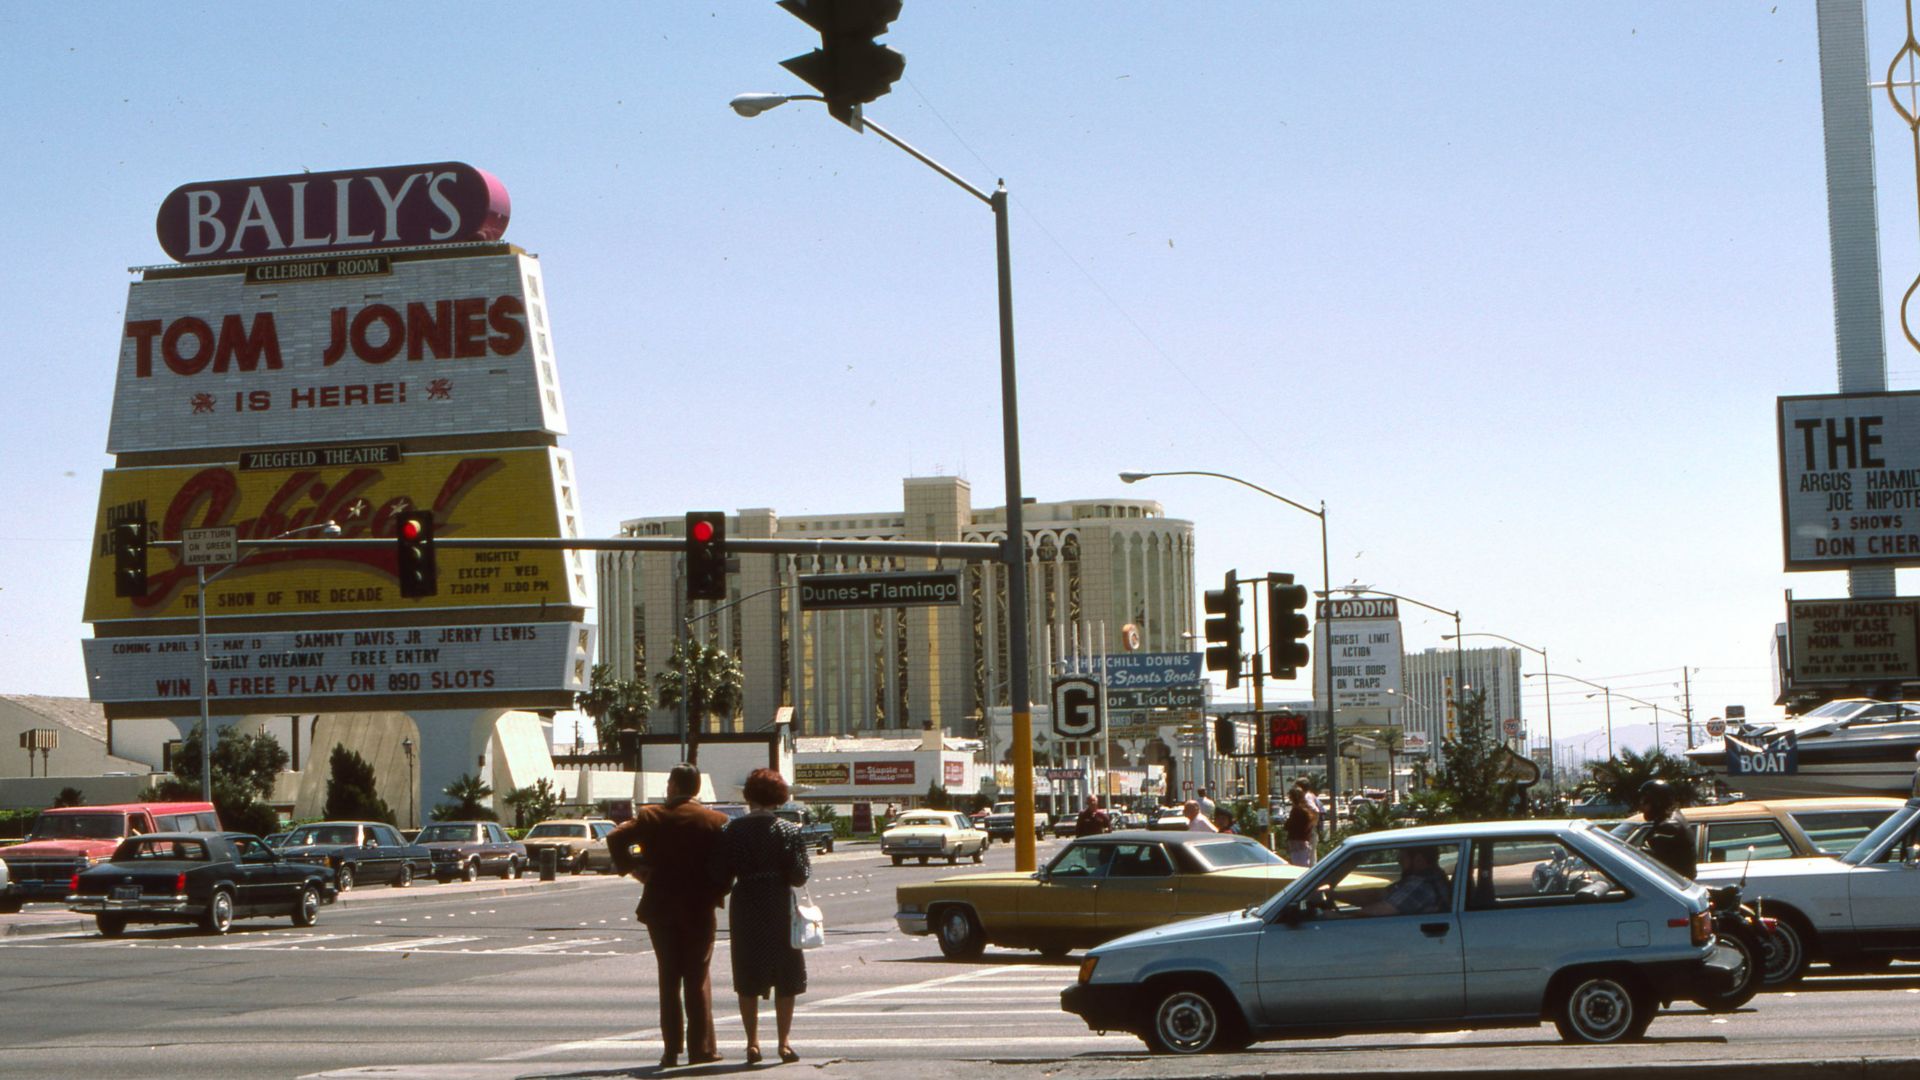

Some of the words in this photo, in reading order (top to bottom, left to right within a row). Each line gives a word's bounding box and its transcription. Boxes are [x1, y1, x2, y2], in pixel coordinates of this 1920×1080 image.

[185, 171, 461, 257] BALLY'S
[256, 263, 328, 280] CELEBRITY
[338, 259, 379, 275] ROOM
[126, 312, 283, 377] TOM
[324, 295, 526, 367] JONES
[236, 386, 272, 412] IS
[291, 382, 406, 409] HERE!
[1794, 416, 1885, 471] THE
[250, 451, 316, 468] ZIEGFELD
[324, 447, 389, 465] THEATRE
[1800, 472, 1851, 492] ARGUS
[1827, 492, 1853, 511] JOE
[1831, 517, 1840, 530] 3
[1851, 515, 1903, 529] SHOWS
[188, 531, 207, 540] LEFT
[211, 530, 231, 539] TURN
[189, 543, 199, 551] ON
[207, 542, 231, 550] GREEN
[1816, 538, 1855, 556] DON
[188, 554, 211, 563] ARROW
[215, 553, 232, 562] ONLY
[475, 551, 520, 563] NIGHTLY
[459, 568, 500, 579] EXCEPT
[514, 565, 538, 576] WED
[533, 581, 549, 591] PM
[803, 581, 957, 601] Dunes-Flamingo
[184, 595, 206, 608] TH
[218, 592, 254, 607] SHOW
[267, 591, 283, 605] OF
[296, 589, 321, 604] THE
[330, 587, 383, 602] DECADE
[1795, 604, 1839, 619] SANDY
[1814, 619, 1889, 633] SHOWCASE
[113, 643, 150, 654] COMING
[158, 641, 188, 652] APRIL
[224, 640, 244, 651] MAY
[252, 639, 262, 650] 13
[295, 632, 344, 649] SAMMY
[404, 630, 421, 645] JR
[438, 627, 482, 643] JERRY
[493, 626, 536, 642] LEWIS
[1331, 634, 1359, 645] IGHEST
[1369, 632, 1390, 644] LIMIT
[1854, 633, 1896, 648] NIGHT
[211, 655, 248, 669] DAILY
[259, 652, 325, 668] GIVEAWAY
[351, 650, 386, 666] FREE
[396, 648, 439, 664] ENTRY
[1343, 646, 1371, 657] ACTION
[1146, 655, 1190, 667] DOWNS
[156, 679, 191, 697] WIN
[207, 678, 218, 696] A
[229, 676, 275, 695] FREE
[288, 673, 338, 694] PLAY
[347, 673, 375, 691] ON
[388, 672, 420, 691] 890
[431, 669, 495, 689] SLOTS
[1115, 669, 1162, 686] Sports
[1164, 668, 1197, 682] Book
[1056, 681, 1095, 734] G
[1740, 753, 1787, 773] BOAT
